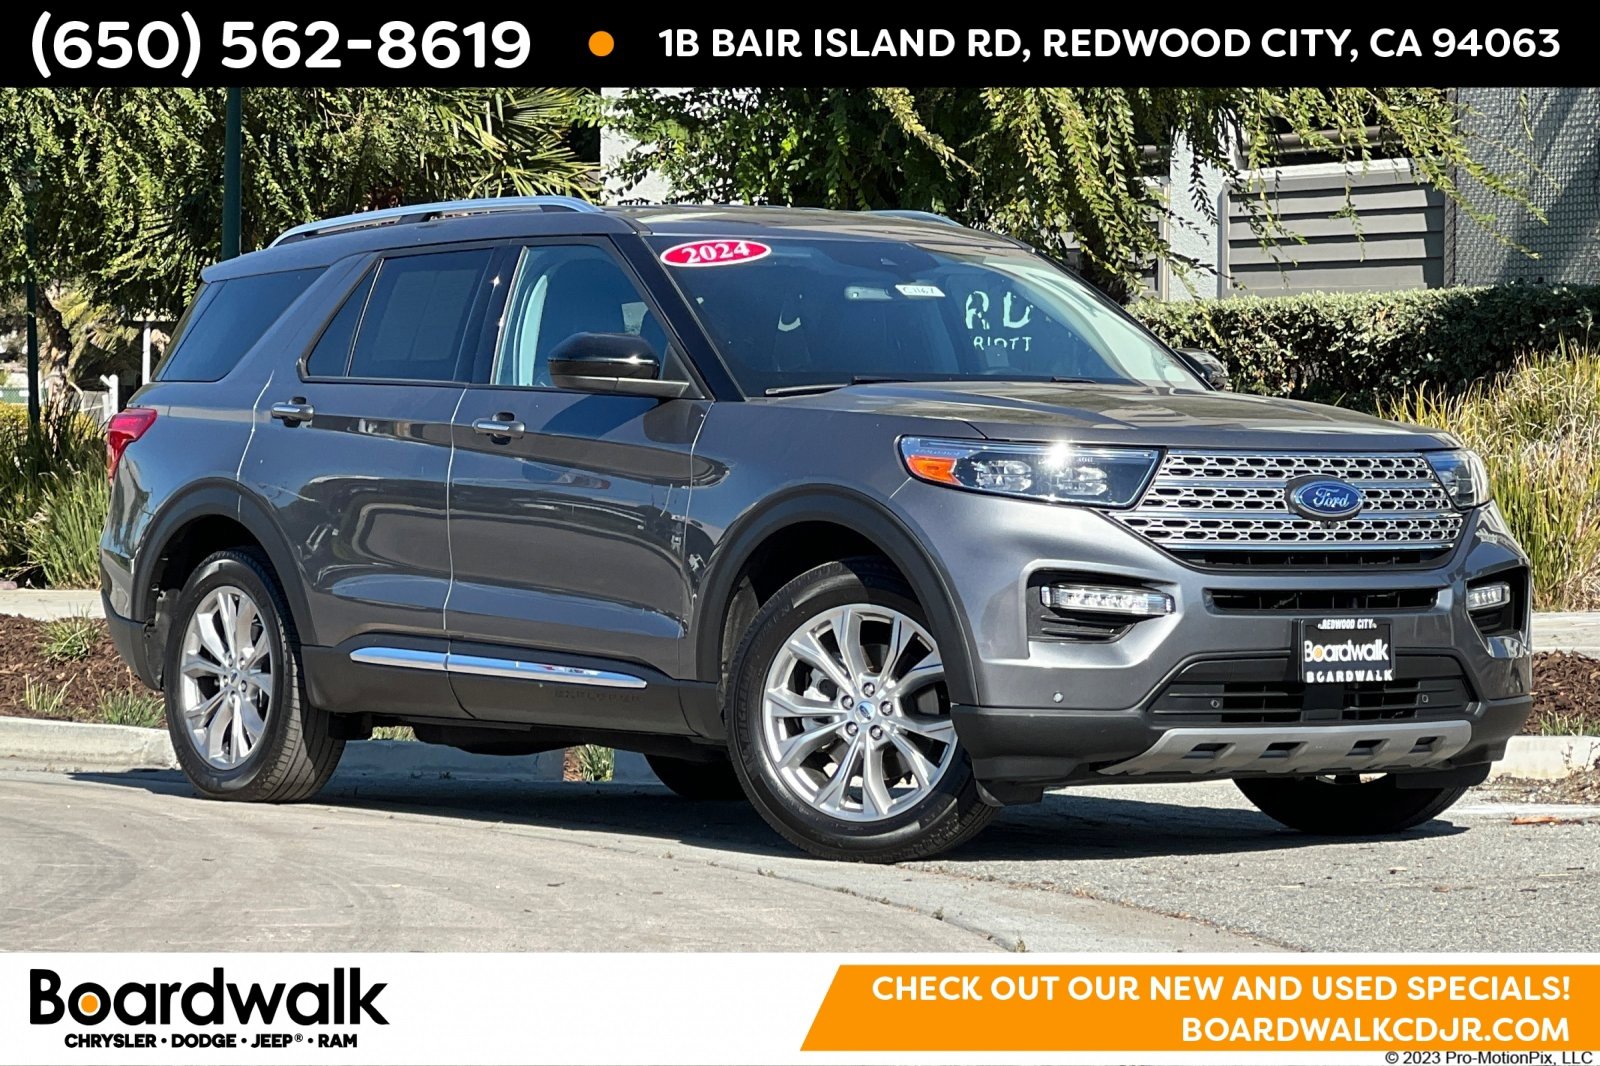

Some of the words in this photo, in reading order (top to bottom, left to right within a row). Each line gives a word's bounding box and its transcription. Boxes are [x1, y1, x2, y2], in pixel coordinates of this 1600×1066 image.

[682, 242, 751, 264] 2024
[1312, 487, 1350, 508] Ford
[1322, 619, 1355, 630] REDWOOD
[1357, 618, 1374, 629] CITY
[1304, 639, 1390, 662] Boardwalk
[1306, 669, 1393, 683] BOARDWALK
